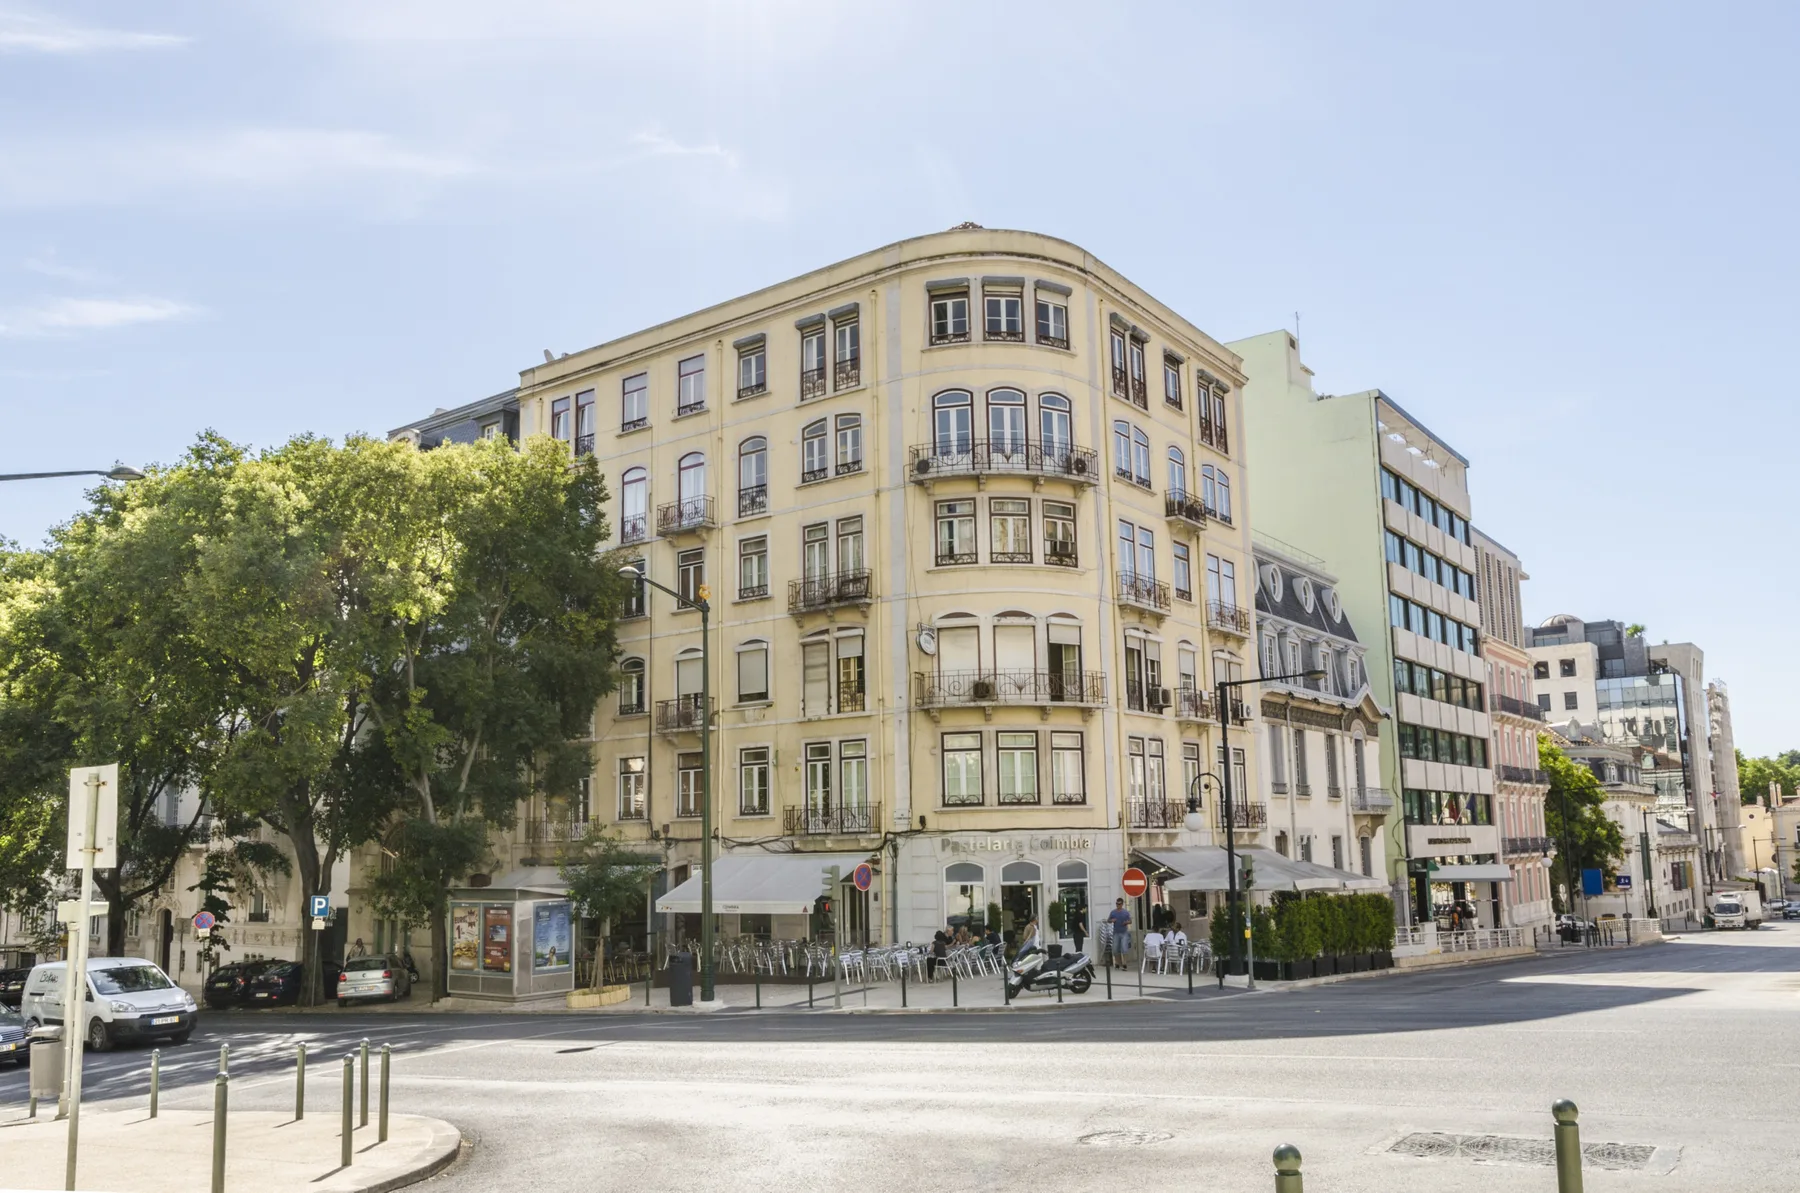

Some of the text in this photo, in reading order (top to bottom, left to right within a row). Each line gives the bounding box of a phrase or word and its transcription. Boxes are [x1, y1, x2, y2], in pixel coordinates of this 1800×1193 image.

[941, 835, 1091, 853] Pastelaria Coimbra
[314, 898, 326, 915] P
